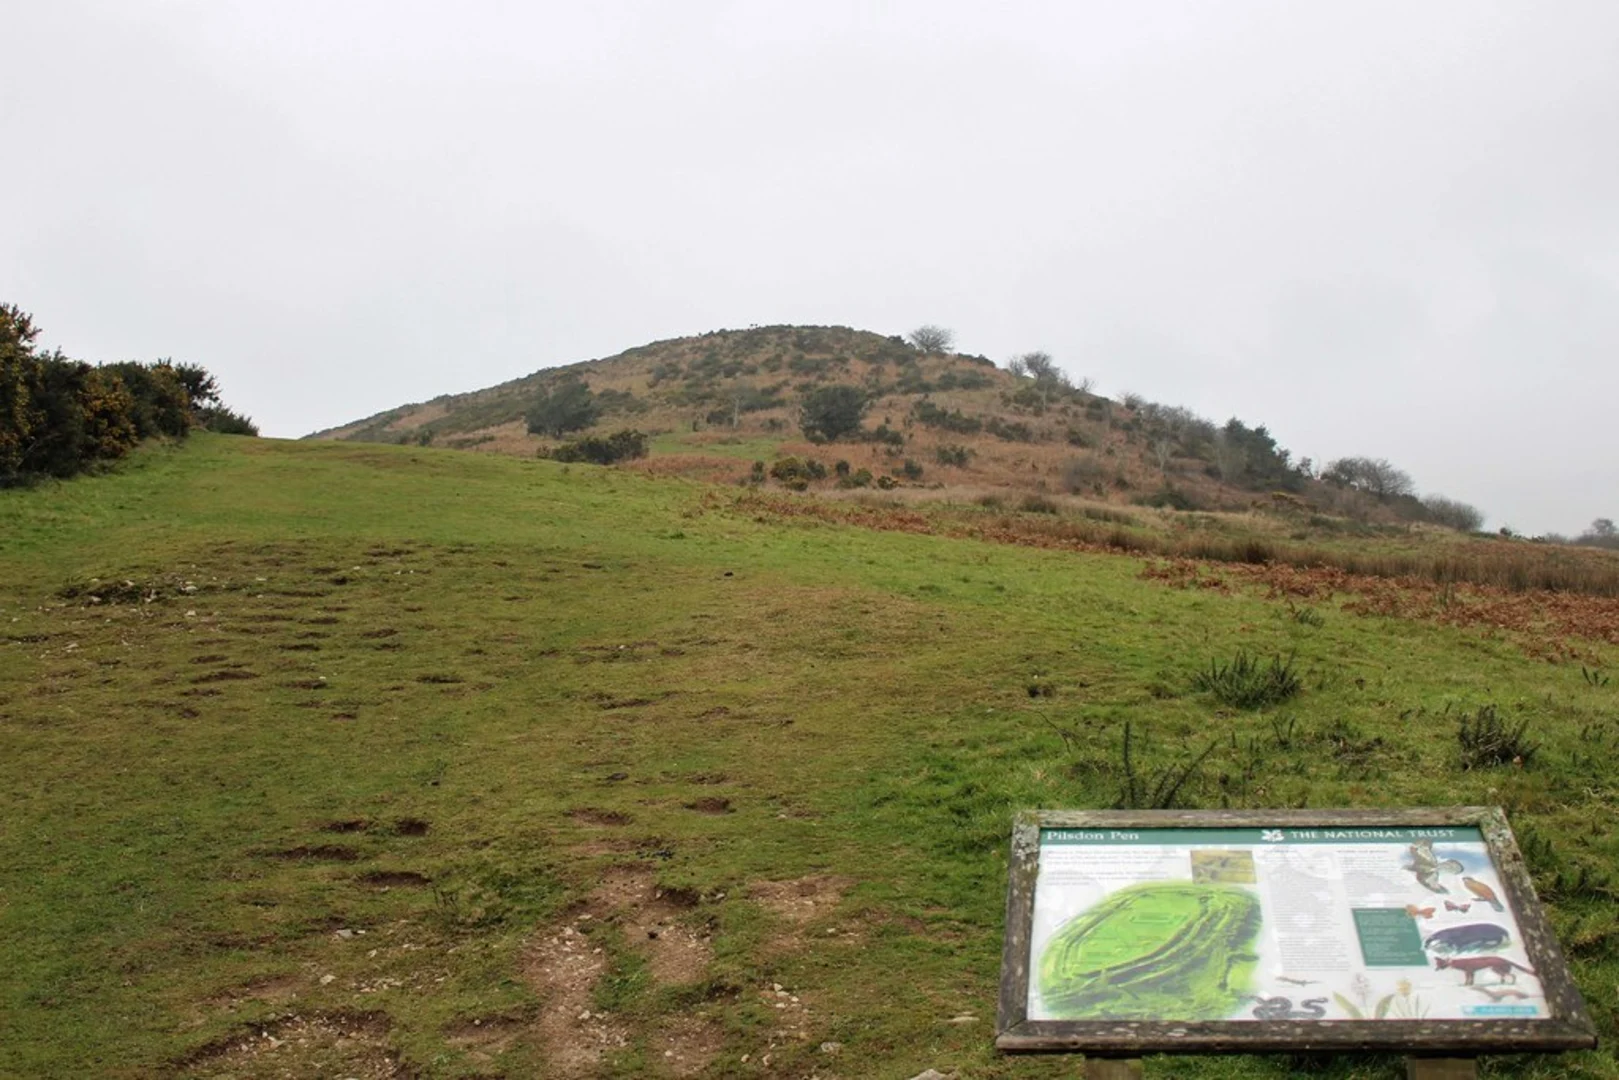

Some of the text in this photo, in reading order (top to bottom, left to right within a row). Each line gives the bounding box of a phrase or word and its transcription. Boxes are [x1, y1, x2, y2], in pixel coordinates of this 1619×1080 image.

[1047, 831, 1140, 840] Pilsdon Pen
[1291, 829, 1455, 839] THE NATIONAL TRUST
